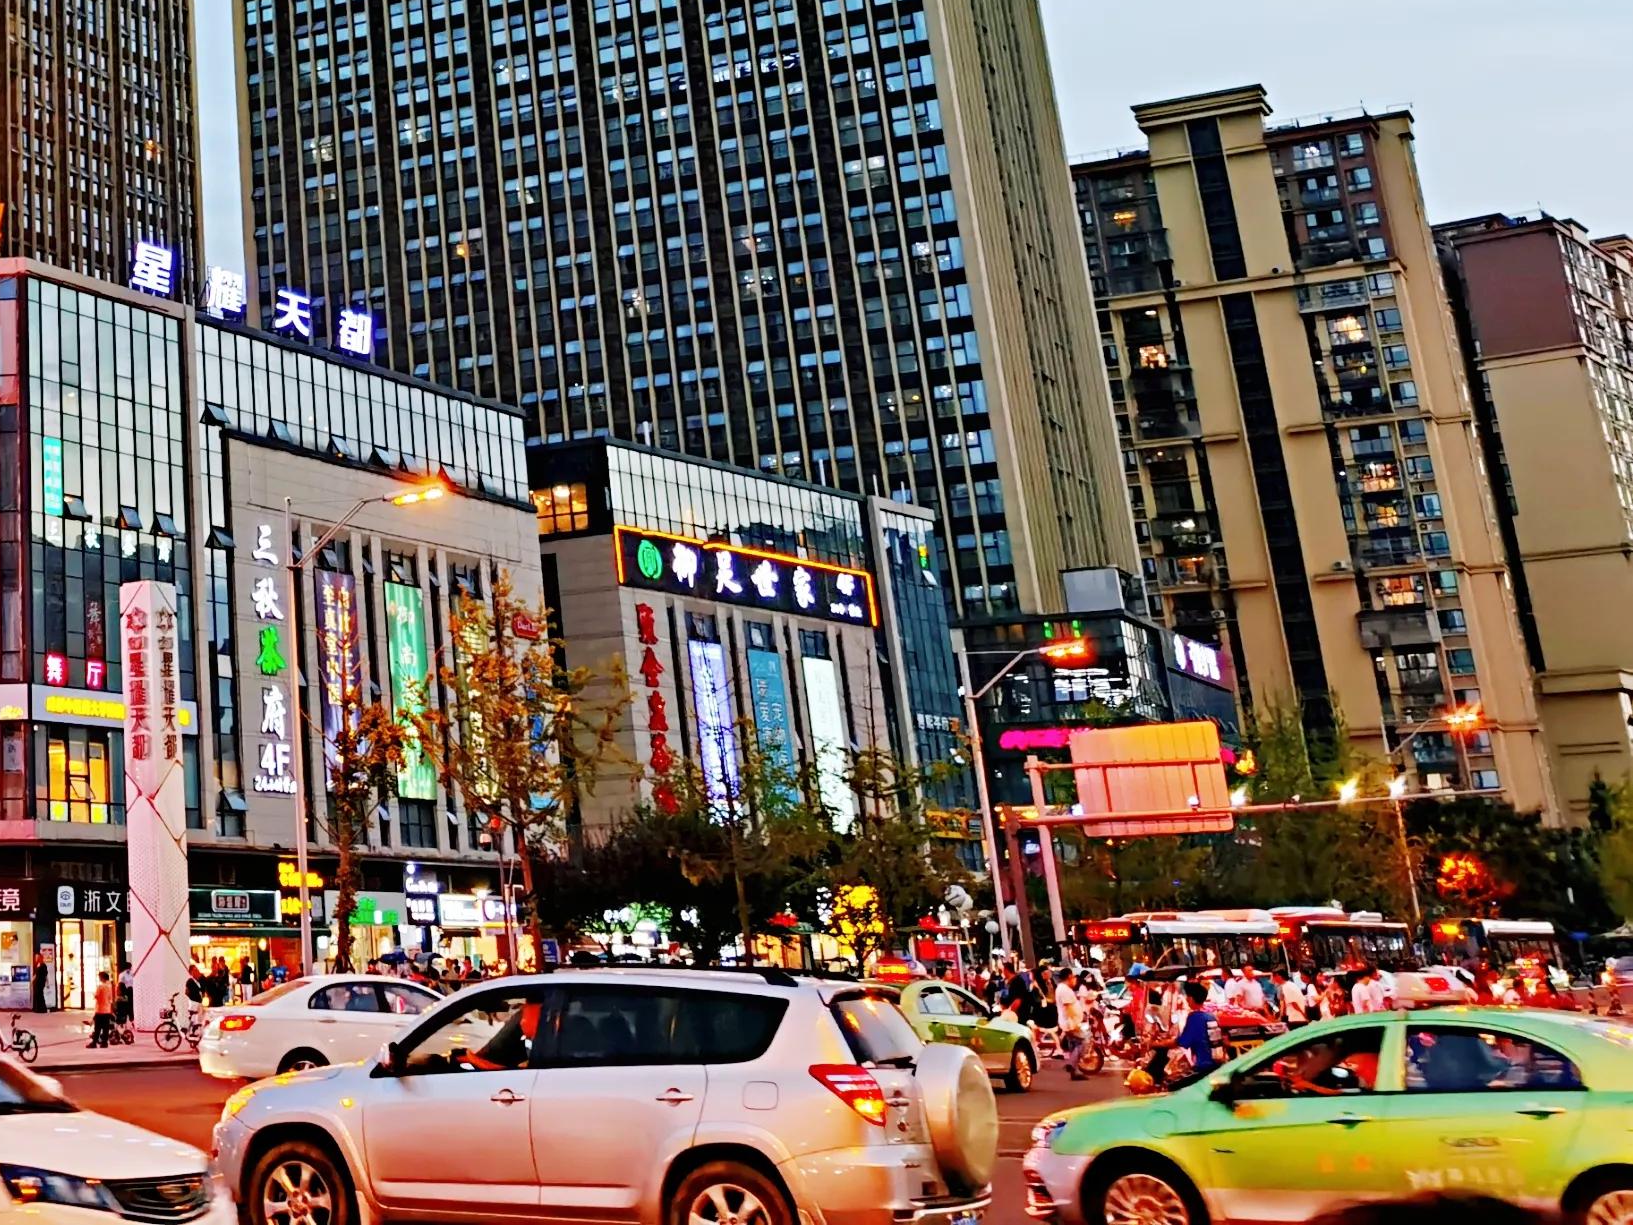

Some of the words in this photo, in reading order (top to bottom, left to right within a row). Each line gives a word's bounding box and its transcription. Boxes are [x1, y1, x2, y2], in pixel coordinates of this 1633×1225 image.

[132, 242, 372, 355] 星耀天都
[252, 525, 288, 741] 三秋茶府
[260, 742, 291, 776] 4F
[84, 889, 130, 913] 浙文
